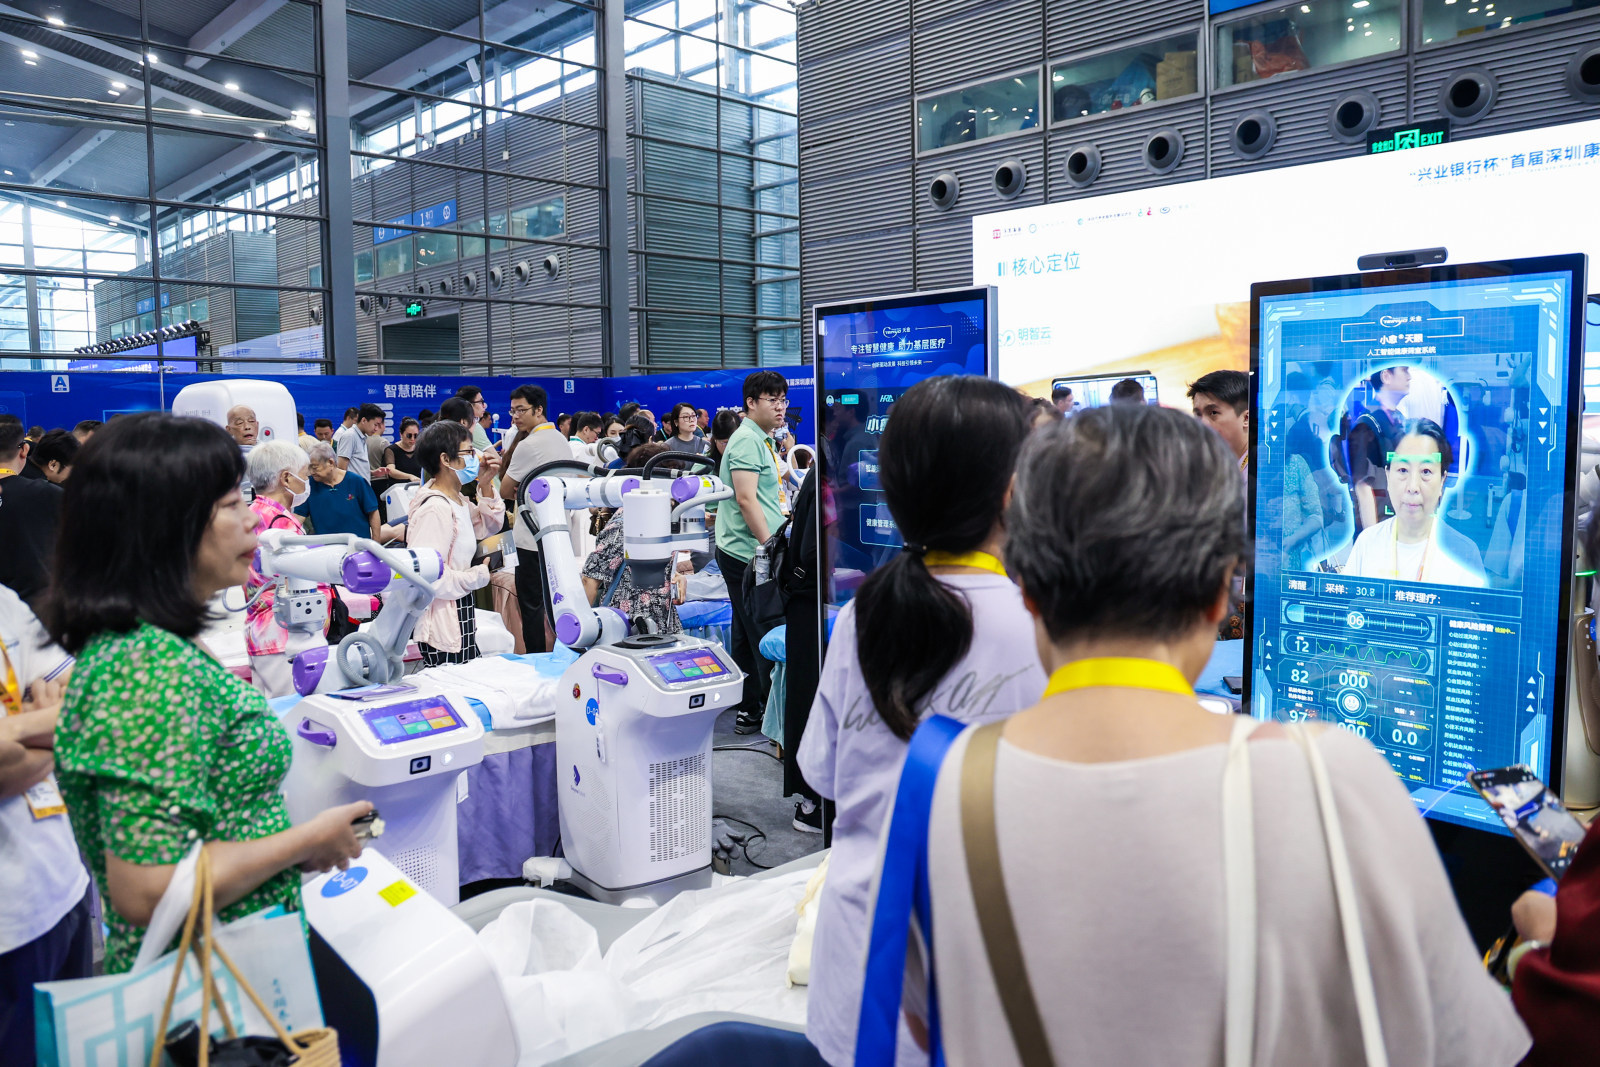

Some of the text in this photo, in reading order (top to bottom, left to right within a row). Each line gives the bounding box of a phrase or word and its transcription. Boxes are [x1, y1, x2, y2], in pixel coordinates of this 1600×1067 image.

[1420, 130, 1444, 147] EXIT
[1012, 251, 1081, 277] 核心定位
[1017, 326, 1052, 341] 明智云
[850, 338, 946, 355] 专注智慧健康 助力基层医疗
[54, 376, 67, 388] A
[566, 380, 572, 389] B
[383, 383, 437, 399] 智慧陪伴
[1288, 579, 1307, 591] 清醒
[1349, 614, 1364, 626] 06
[1294, 640, 1310, 653] 12
[1290, 668, 1309, 684] 82
[1338, 672, 1368, 689] 000
[1289, 710, 1308, 724] 97
[1391, 728, 1418, 746] 0.0
